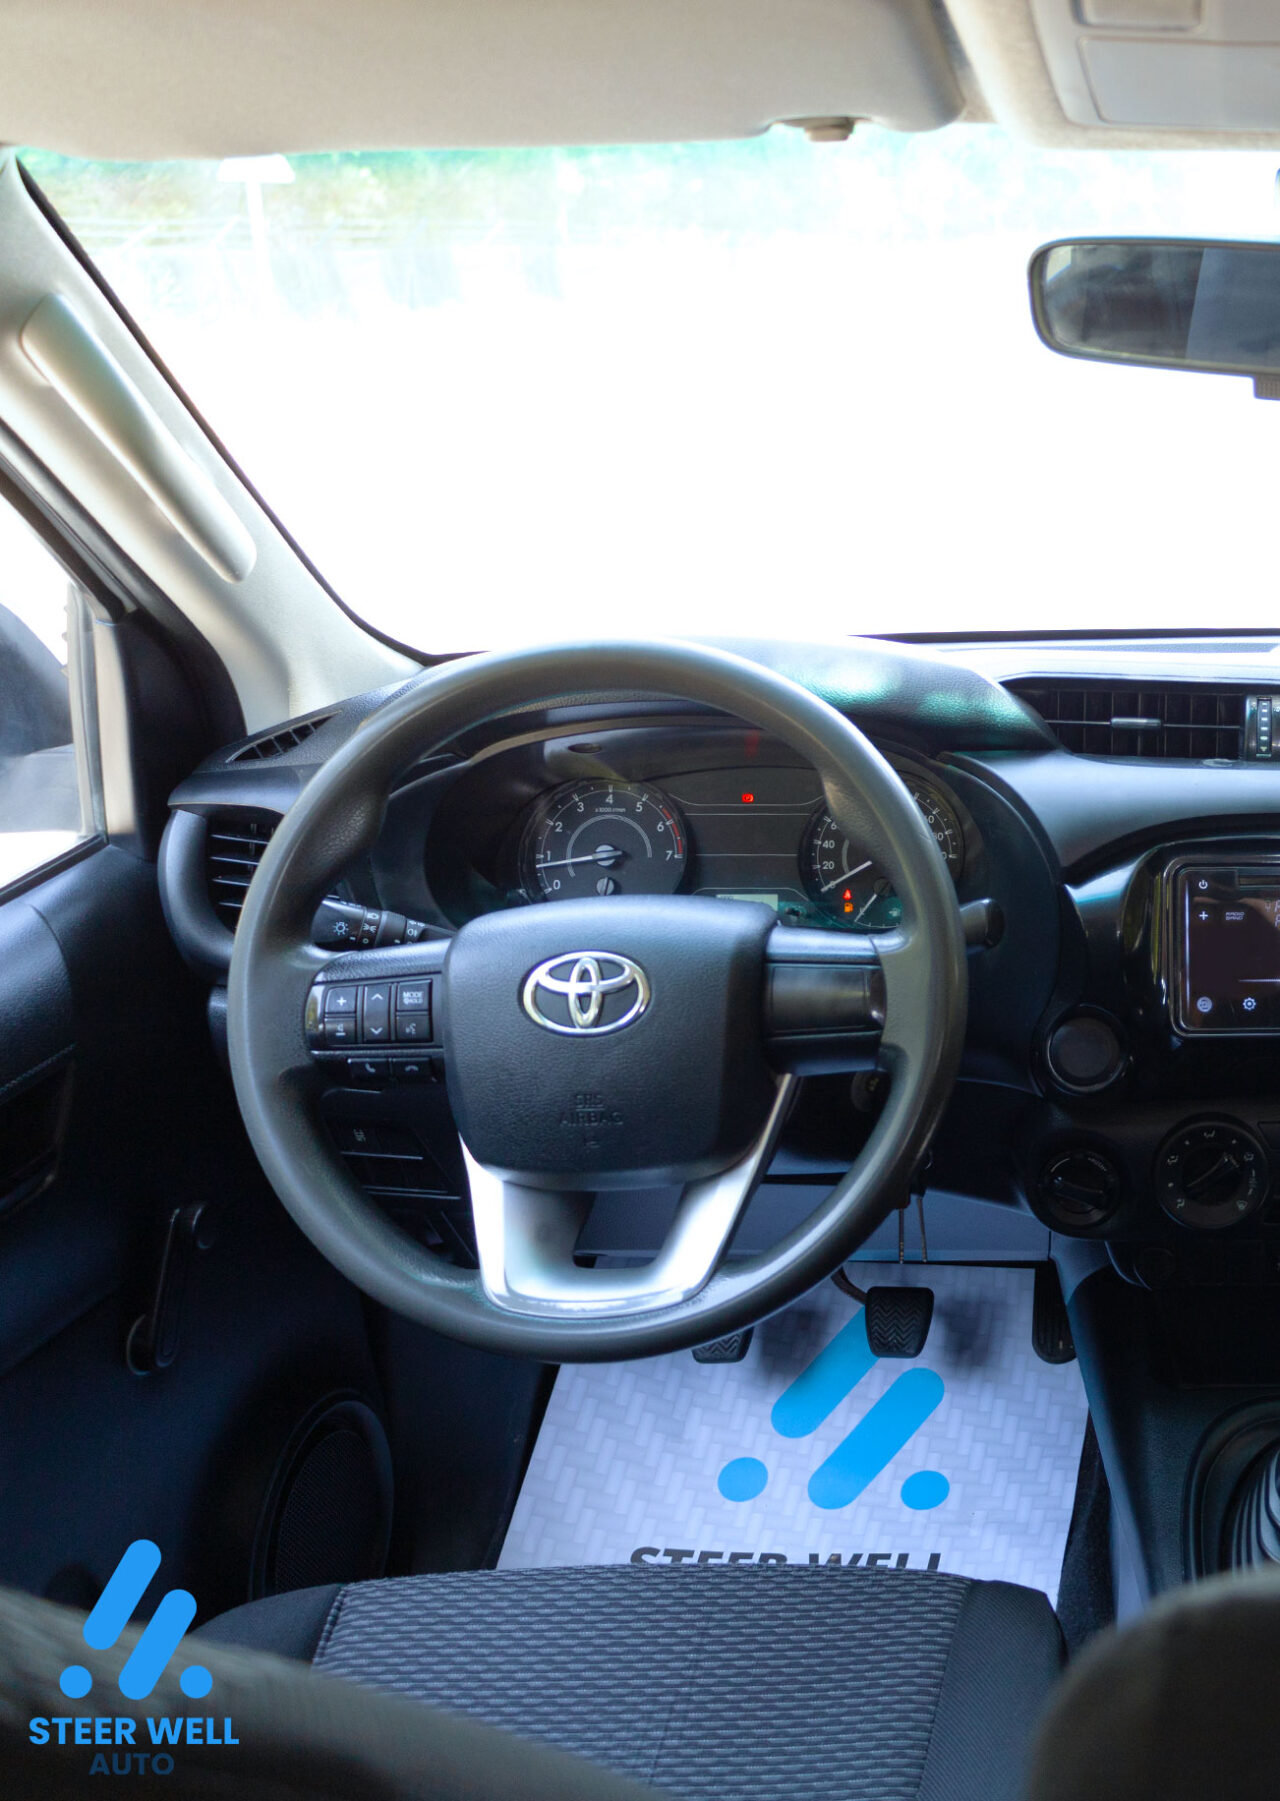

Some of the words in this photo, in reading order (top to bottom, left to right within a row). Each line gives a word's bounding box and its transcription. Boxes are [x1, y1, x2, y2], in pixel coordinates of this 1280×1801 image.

[605, 794, 614, 805] 4
[576, 802, 585, 813] 3
[635, 802, 643, 813] 5
[554, 821, 563, 832] 2
[656, 821, 665, 832] 6
[823, 840, 835, 849] 40
[665, 850, 673, 861] 7
[822, 861, 835, 870] 20
[553, 879, 561, 890] 0
